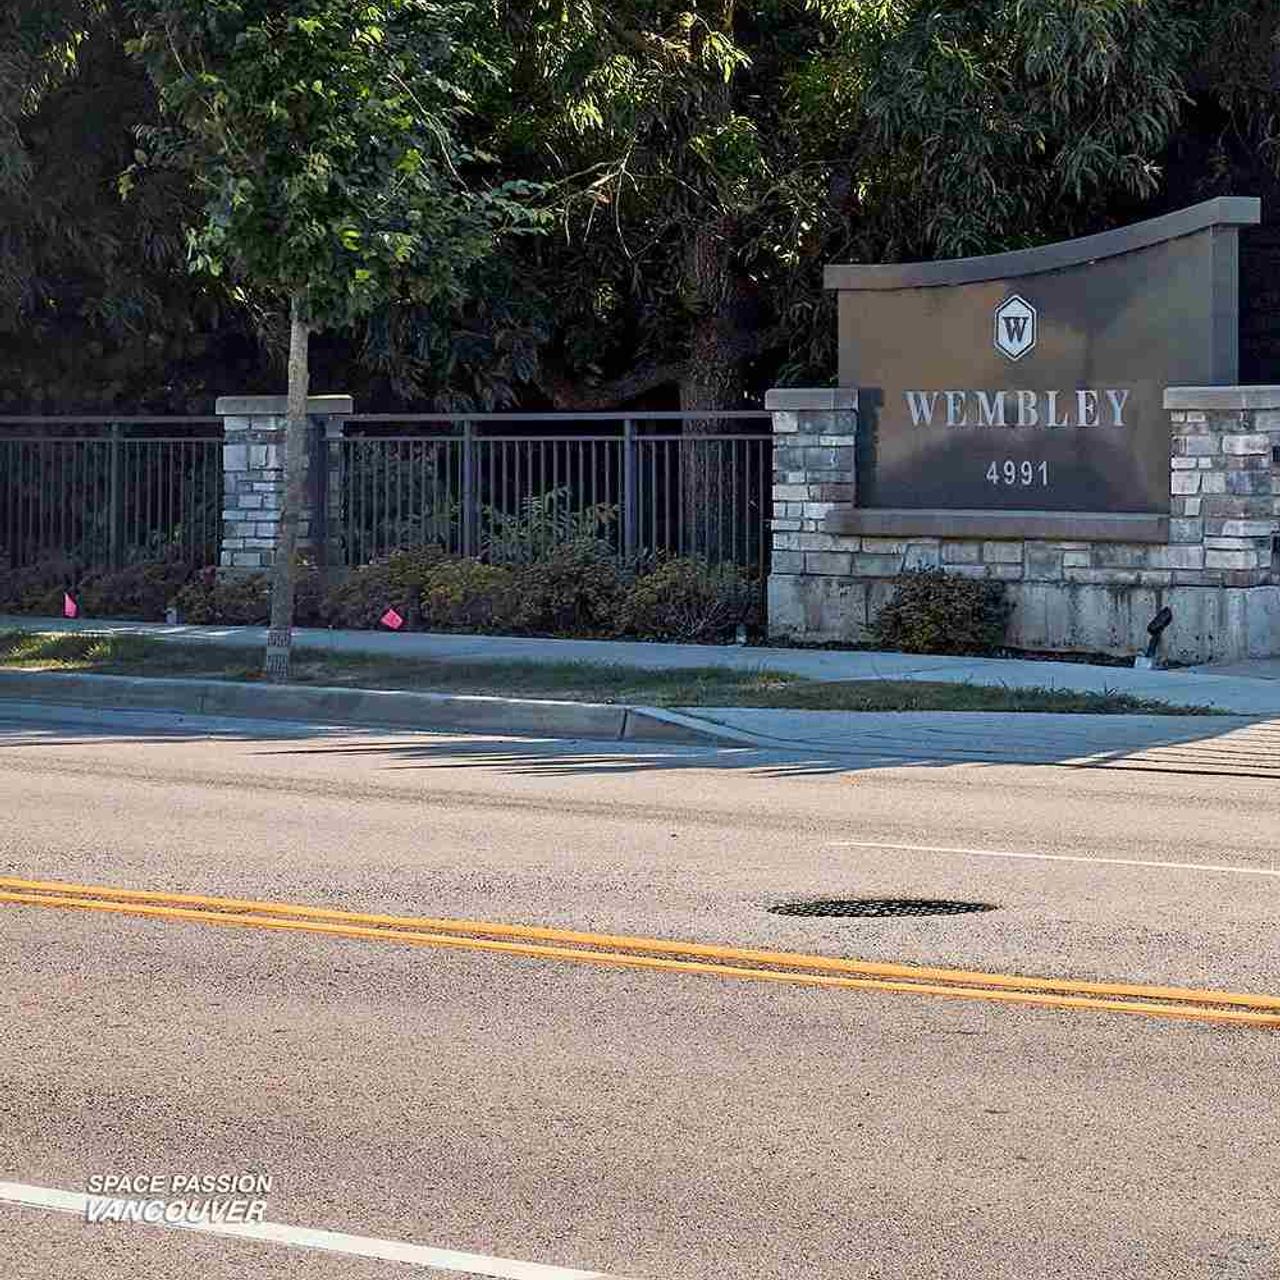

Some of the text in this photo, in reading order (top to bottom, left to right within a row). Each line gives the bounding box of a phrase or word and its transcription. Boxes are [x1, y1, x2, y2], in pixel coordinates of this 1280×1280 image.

[1002, 315, 1029, 343] W
[904, 389, 1131, 428] WEMBLEY
[985, 460, 1048, 486] 4991
